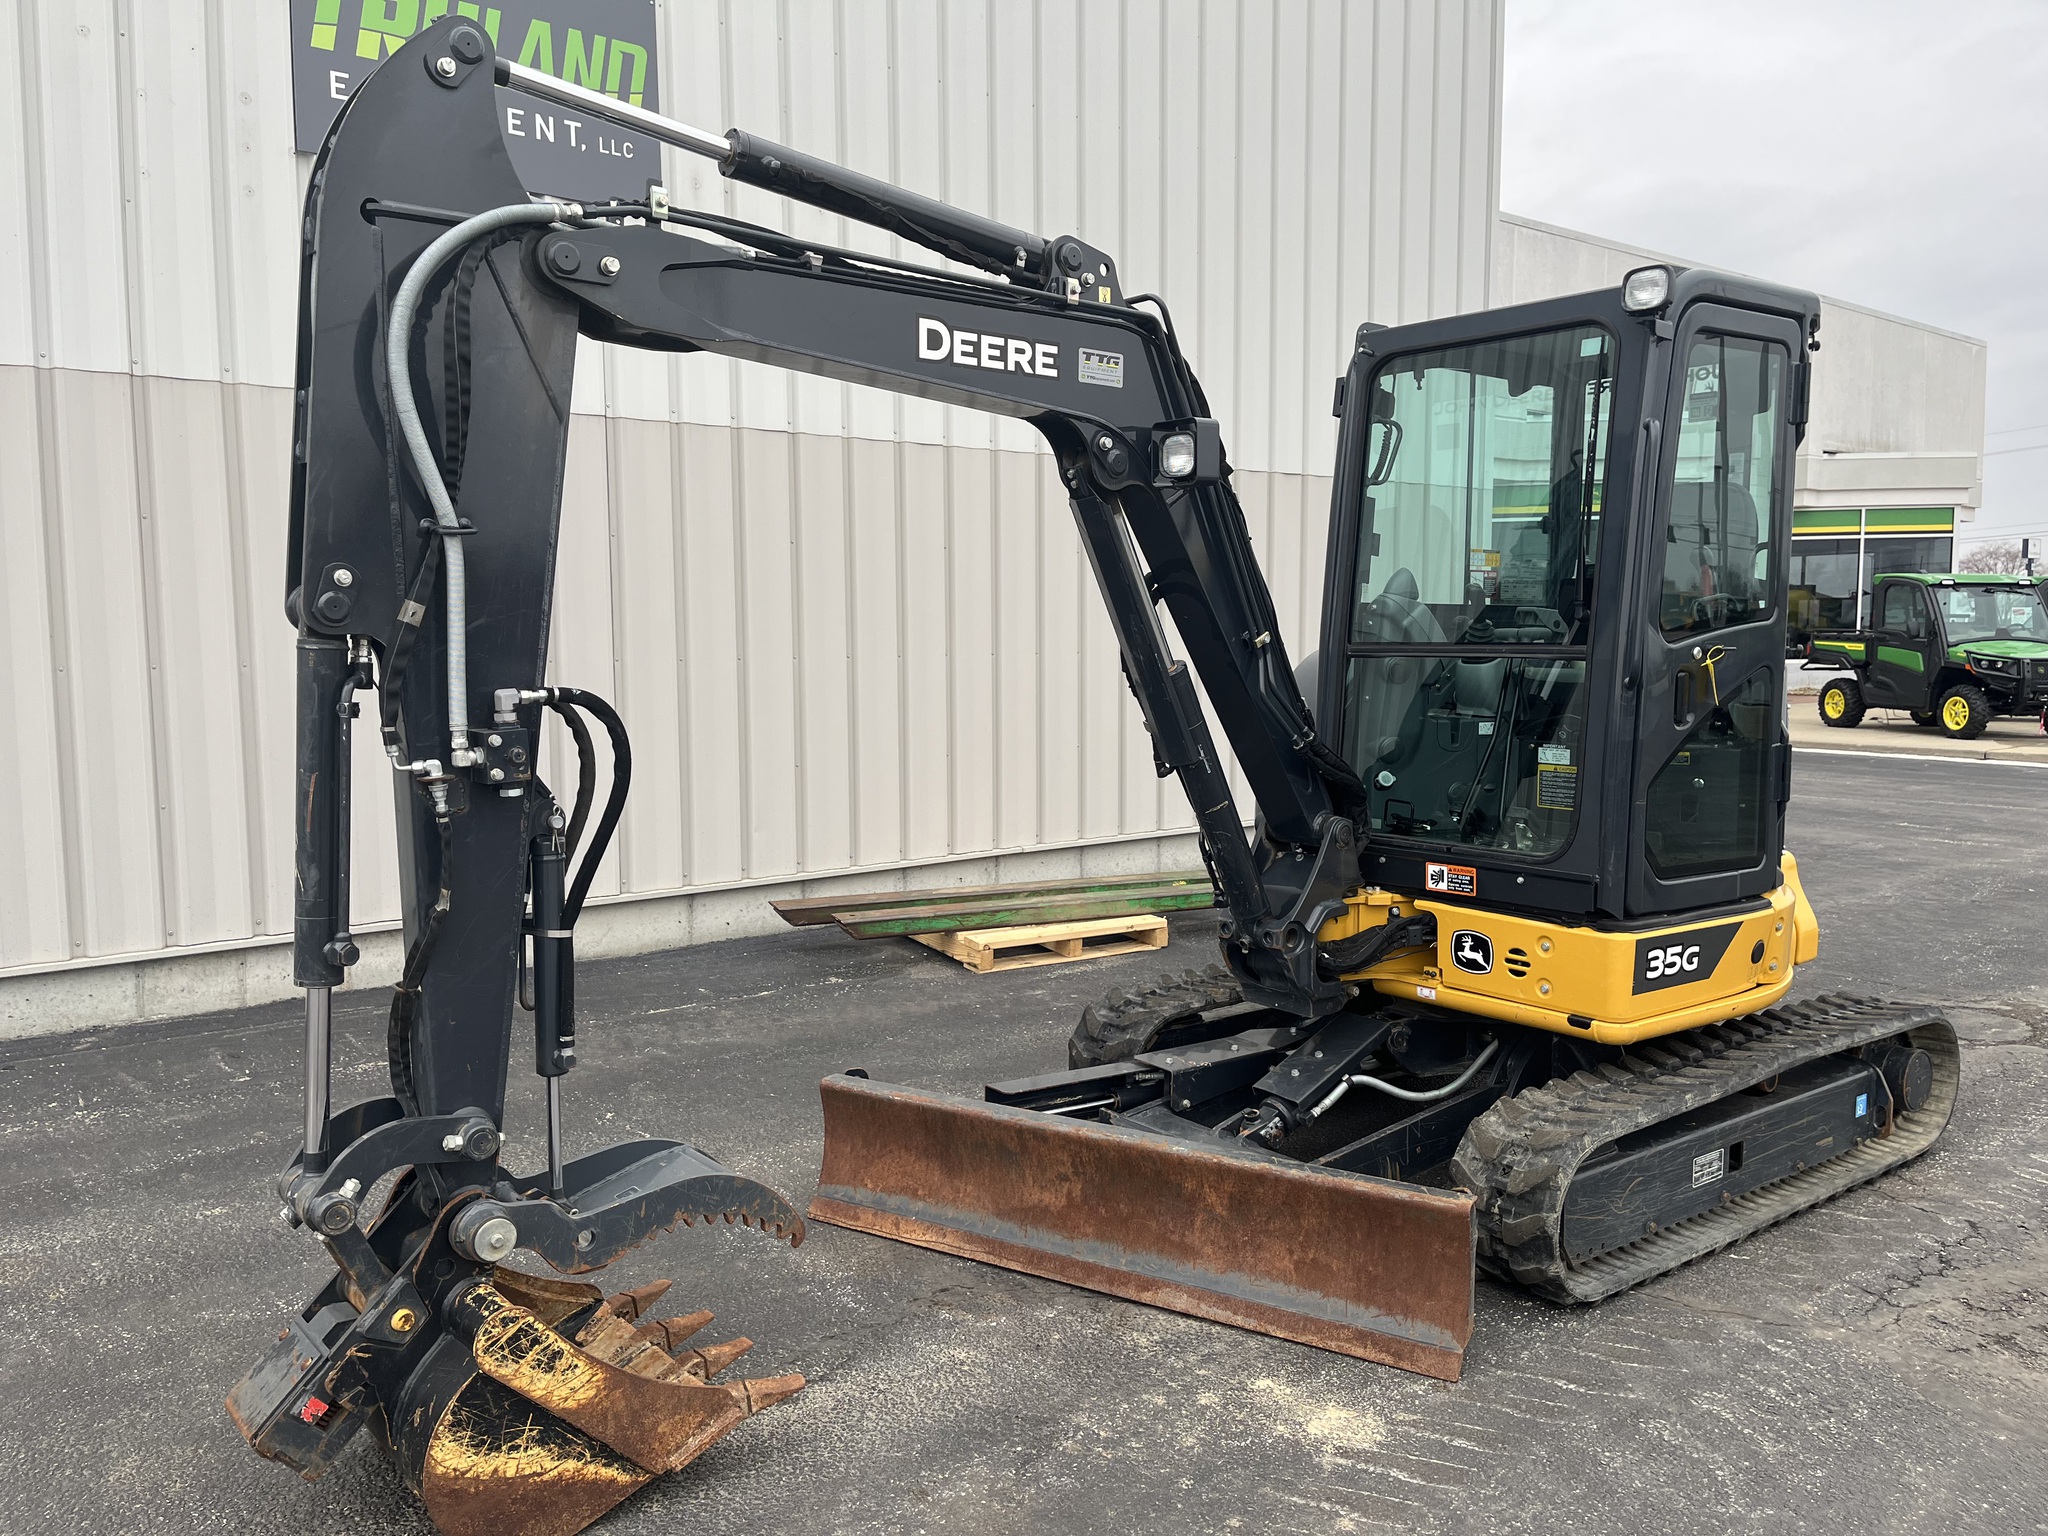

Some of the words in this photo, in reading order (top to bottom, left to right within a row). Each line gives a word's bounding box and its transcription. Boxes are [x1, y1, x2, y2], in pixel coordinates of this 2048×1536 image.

[329, 69, 587, 152] EENT,
[599, 136, 634, 159] LLC
[918, 317, 1058, 378] DEERE
[1082, 351, 1120, 369] TTG
[1083, 365, 1118, 374] EQUIPMENT
[1453, 867, 1474, 875] WARNING
[1646, 945, 1700, 979] 35G
